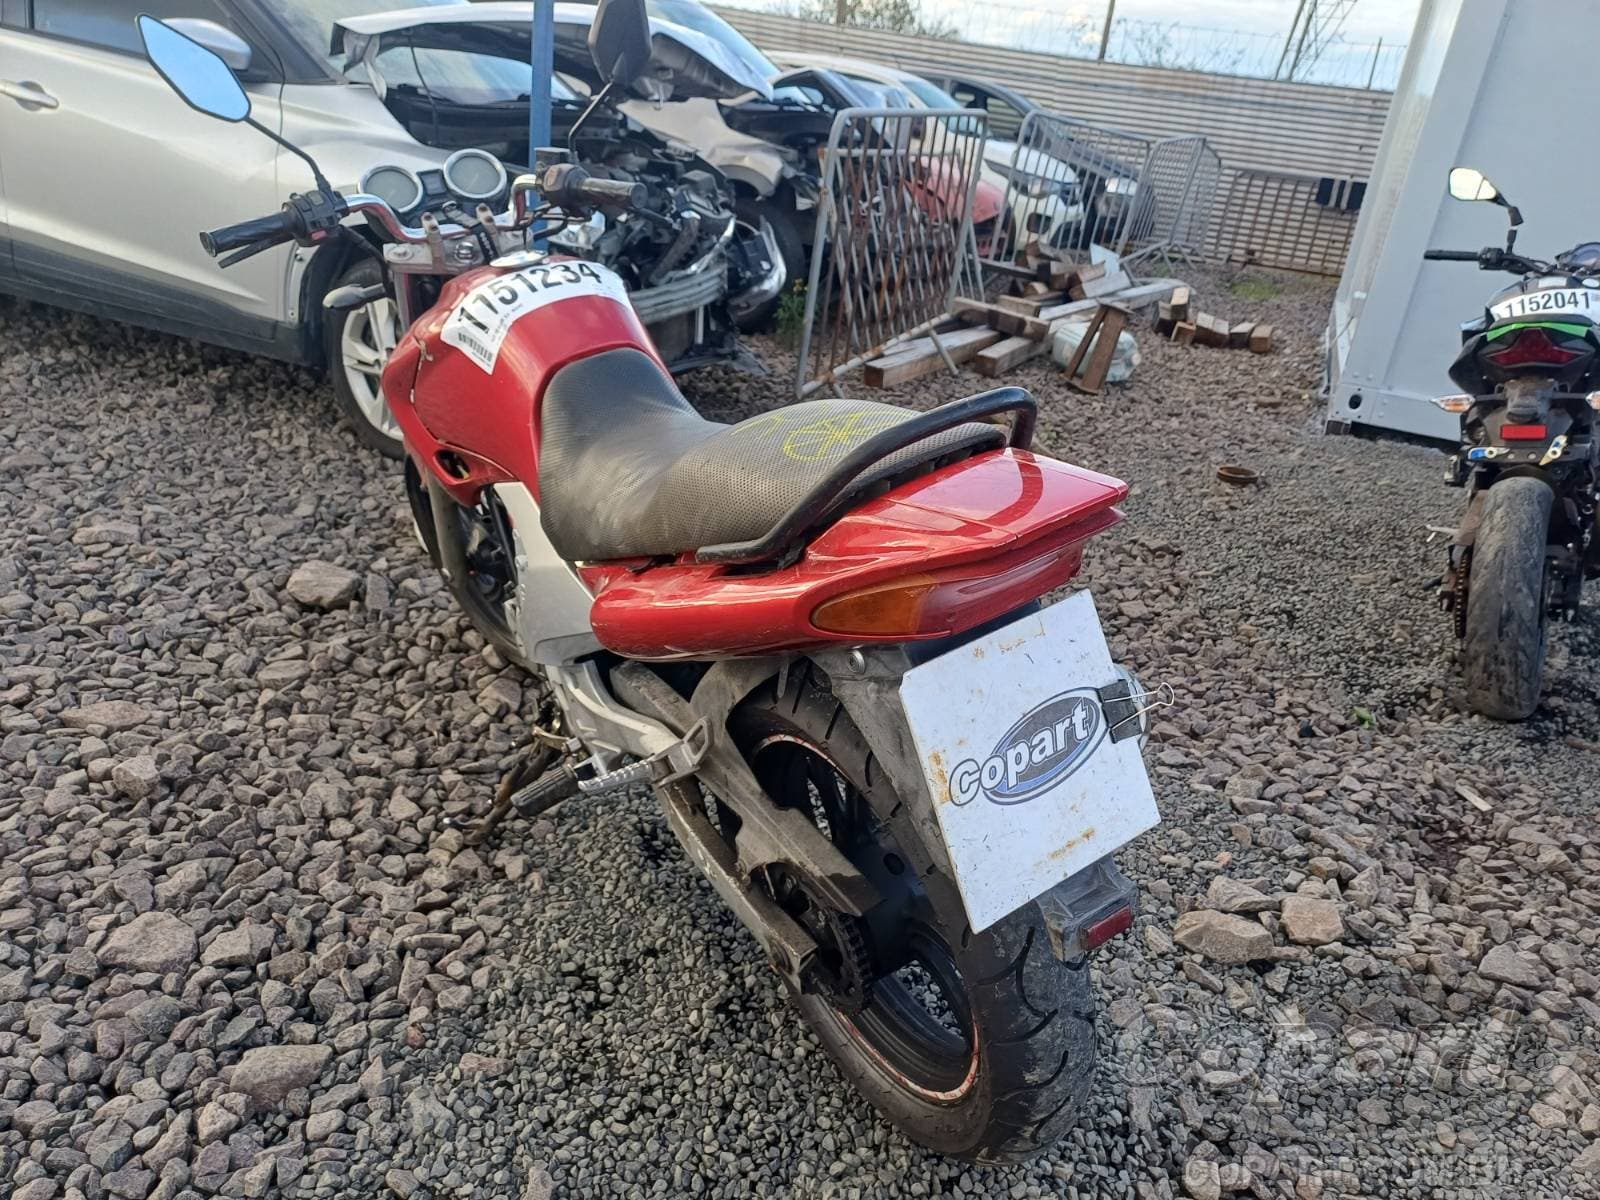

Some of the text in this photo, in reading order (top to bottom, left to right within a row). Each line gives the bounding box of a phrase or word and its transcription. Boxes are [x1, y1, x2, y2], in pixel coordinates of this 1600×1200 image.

[458, 263, 602, 334] 1151234
[1504, 291, 1590, 319] 1152041
[949, 701, 1091, 807] Copart
